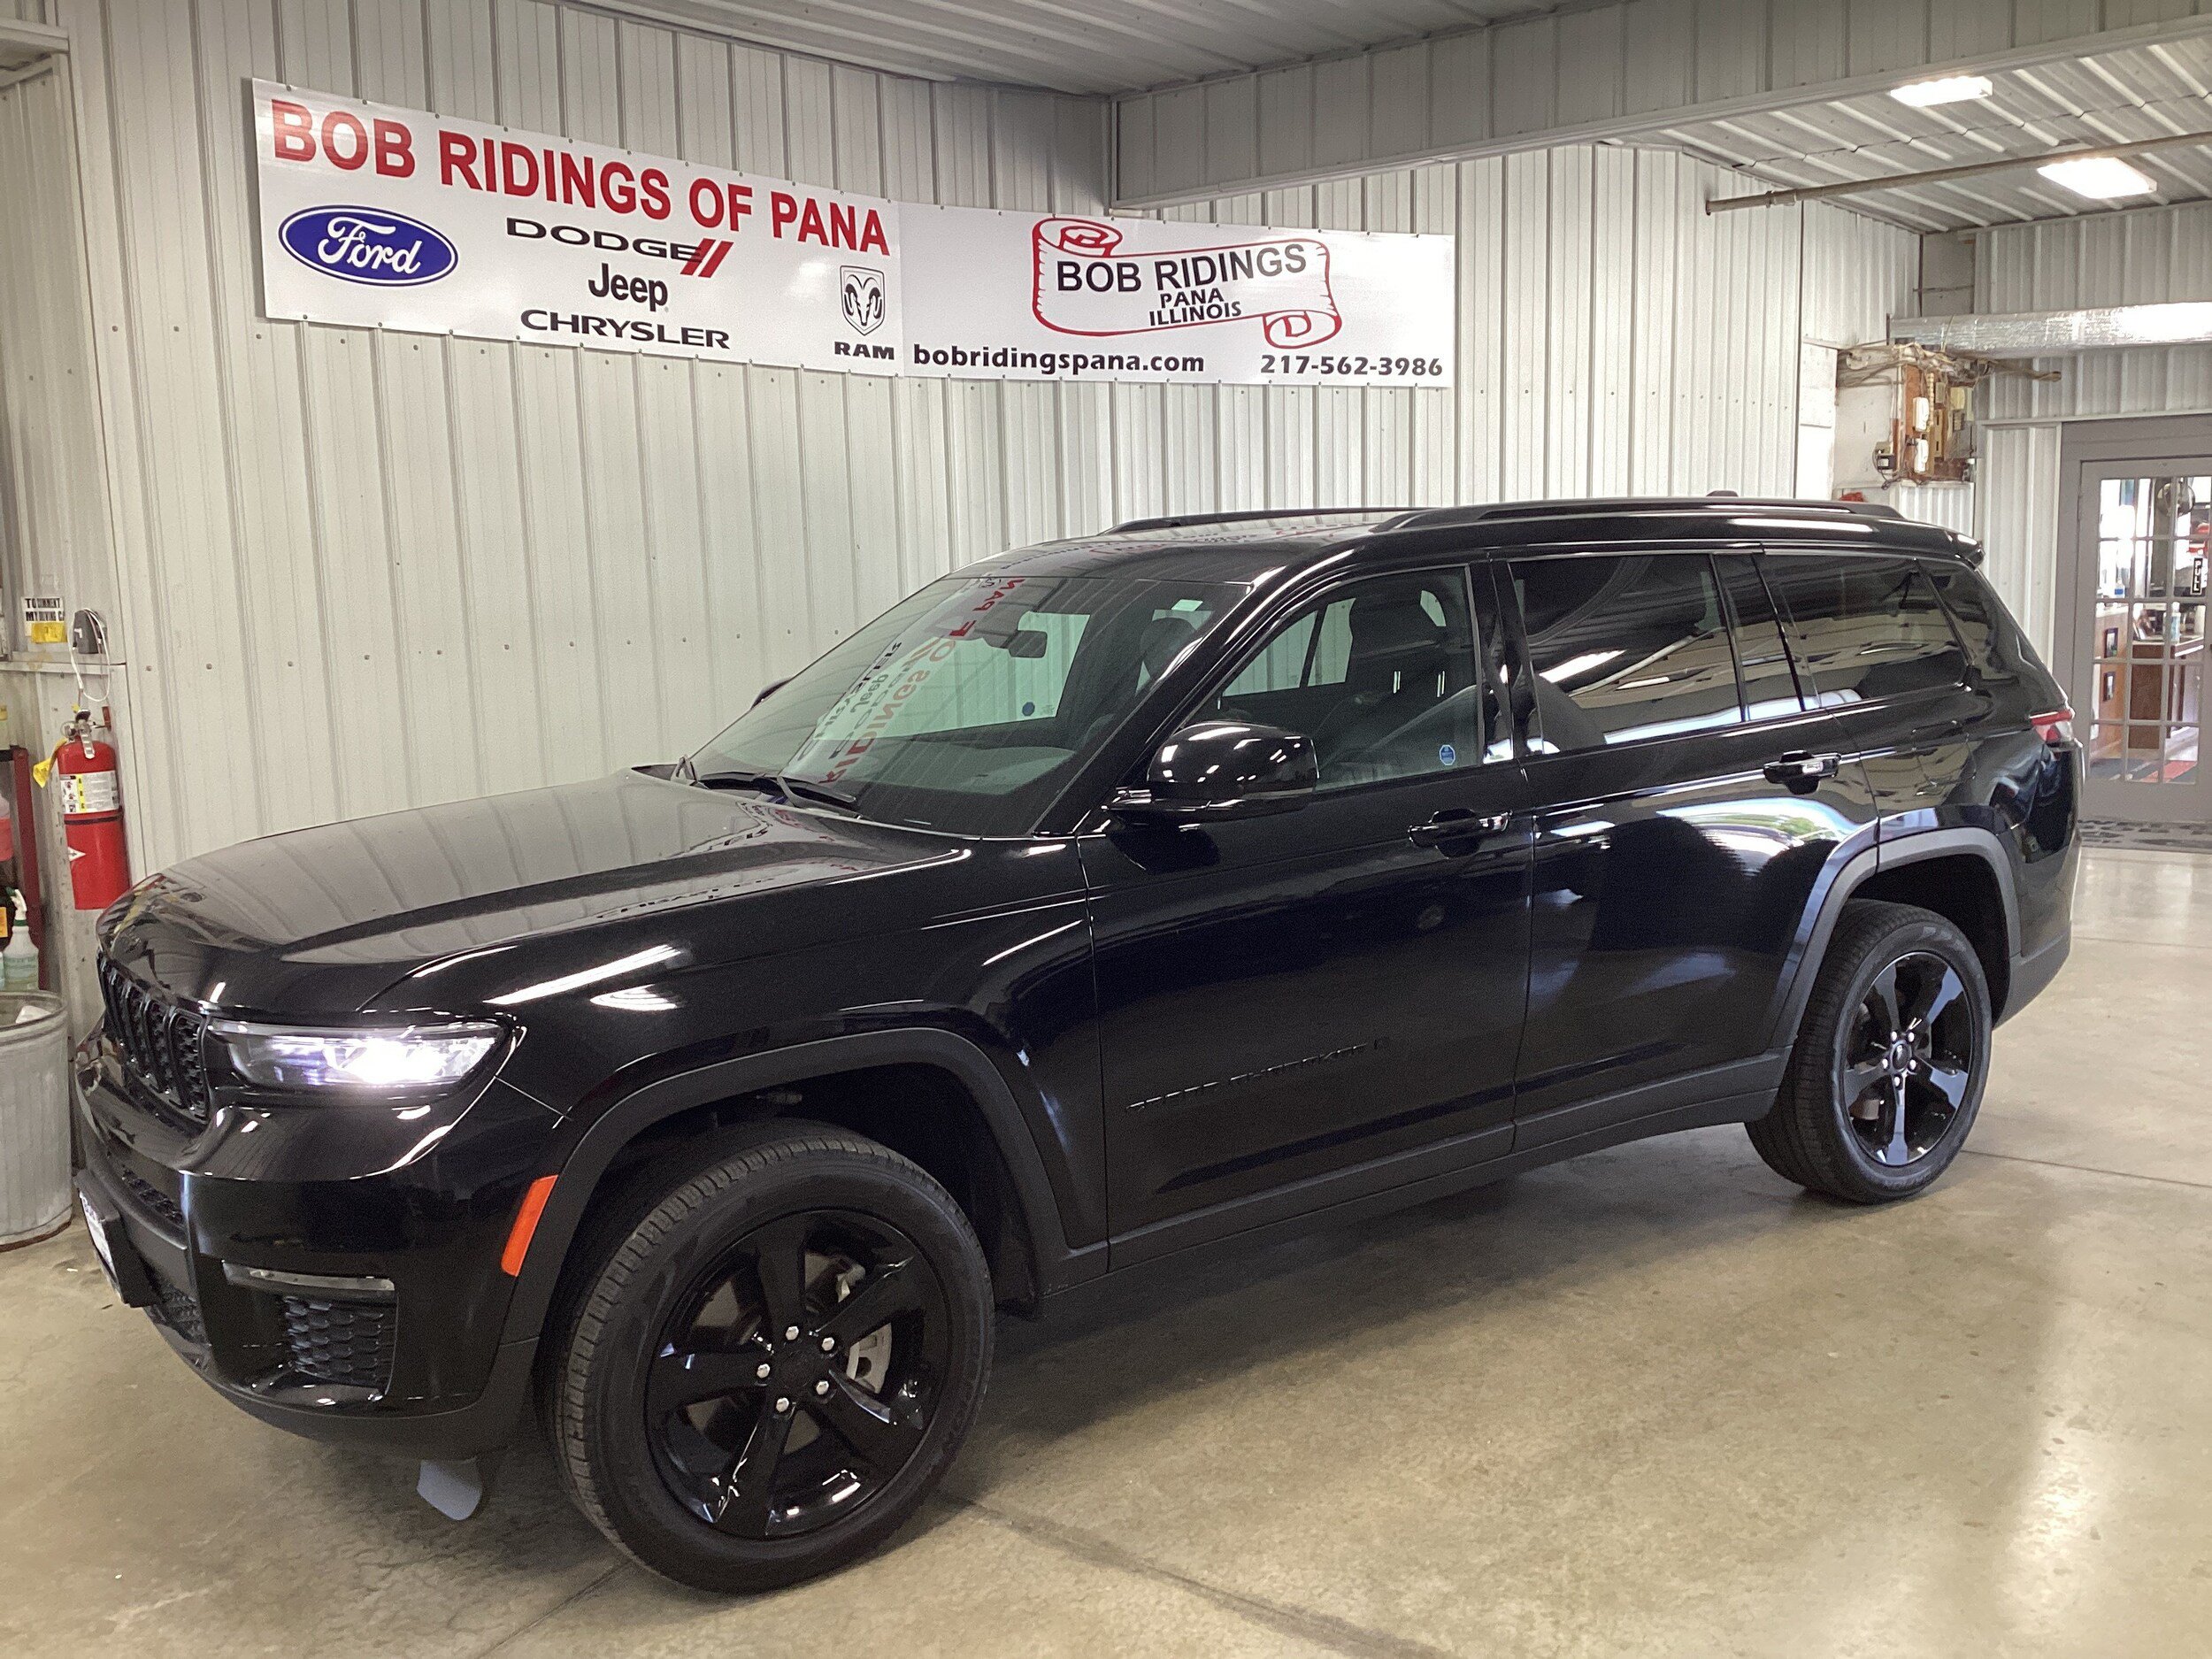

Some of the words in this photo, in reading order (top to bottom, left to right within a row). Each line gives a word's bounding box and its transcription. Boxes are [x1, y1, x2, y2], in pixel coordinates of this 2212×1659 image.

[271, 99, 416, 179] BOB
[439, 130, 672, 220] RIDINGS
[688, 178, 754, 232] OF
[771, 191, 890, 256] PANA
[318, 216, 423, 274] Ford
[506, 217, 702, 264] DODGE
[588, 262, 669, 312] Jeep
[1056, 260, 1142, 293] BOB
[1154, 243, 1307, 292] RIDINGS
[1148, 301, 1241, 327] ILLINOIS
[1159, 288, 1225, 310] PANA
[520, 309, 731, 350] CHRYSLER
[834, 341, 895, 361] RAM
[913, 343, 1205, 377] bobridingspana.com
[1259, 354, 1444, 377] 217-562-3986
